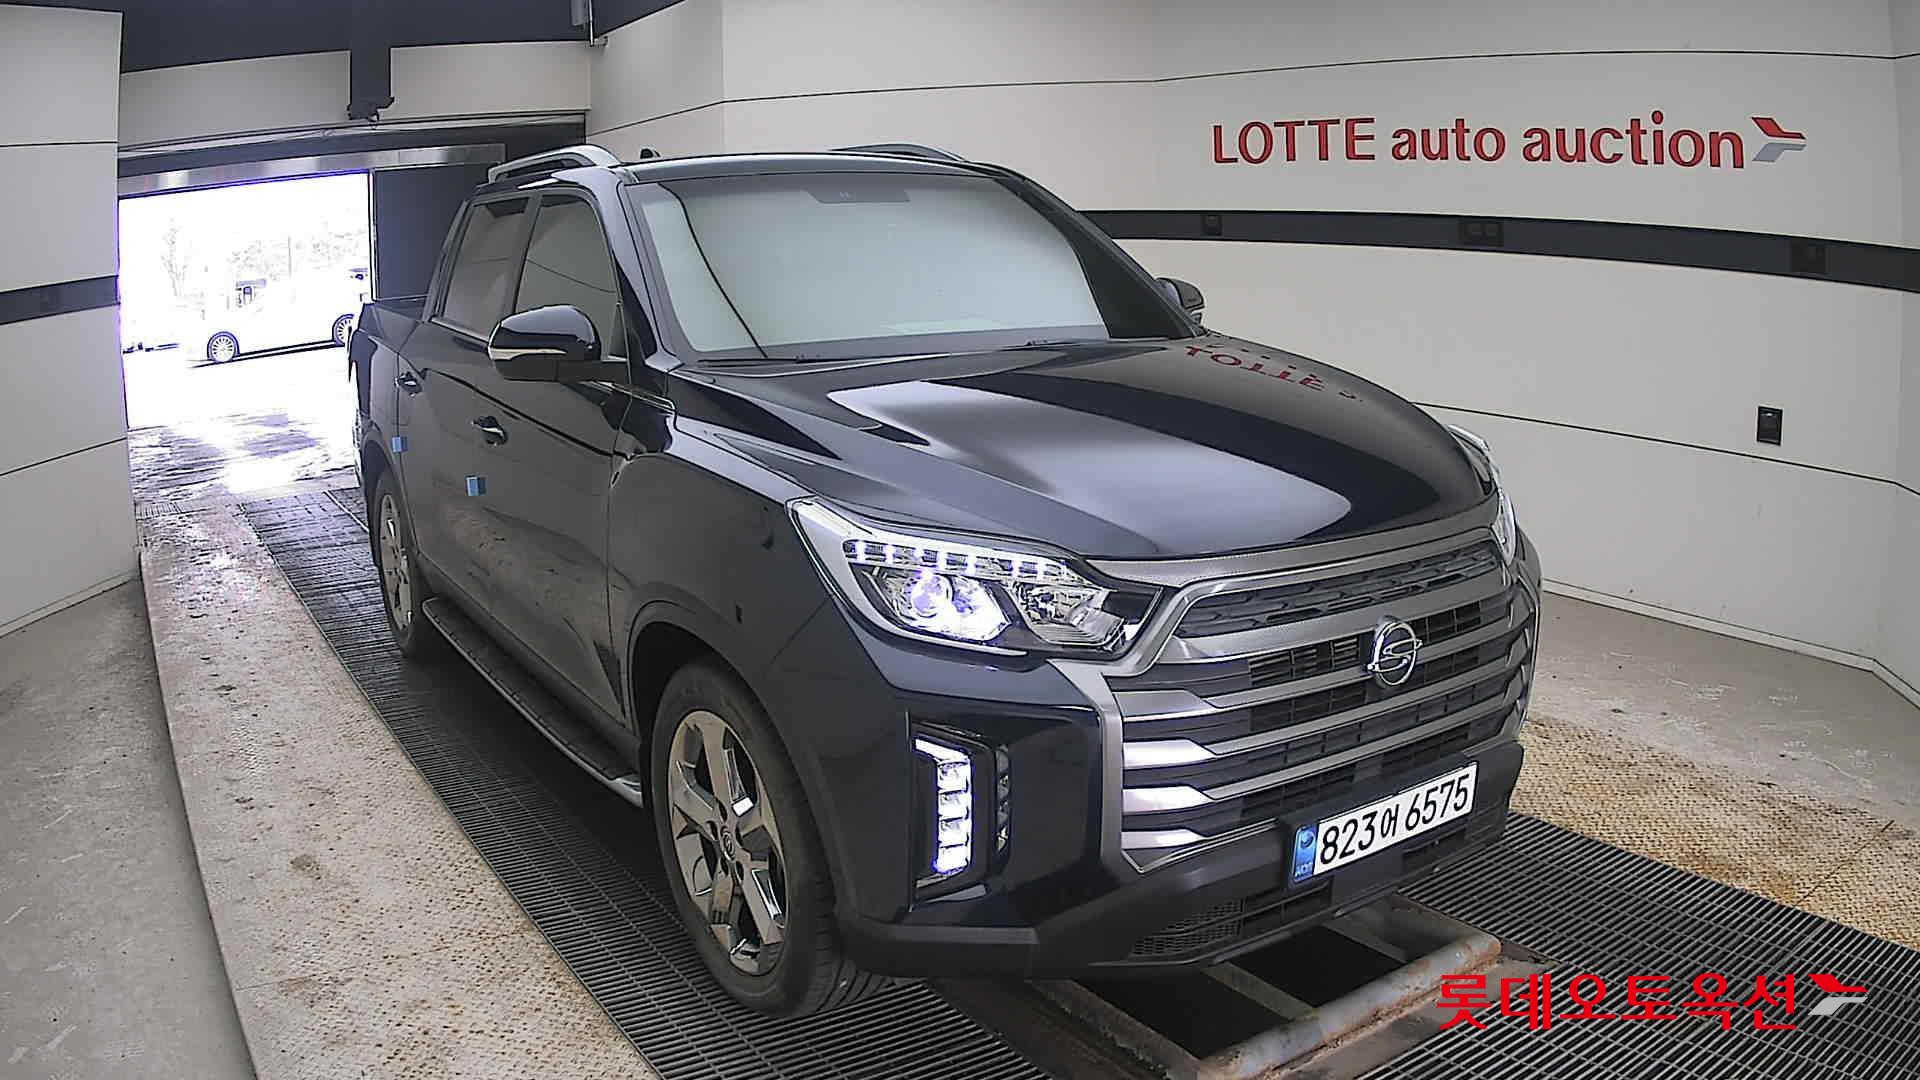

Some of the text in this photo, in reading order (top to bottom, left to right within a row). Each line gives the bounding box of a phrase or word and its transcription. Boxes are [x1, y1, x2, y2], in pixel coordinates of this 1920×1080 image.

[1213, 110, 1745, 169] LOTTE auto auction
[1319, 774, 1470, 865] 823어 6575
